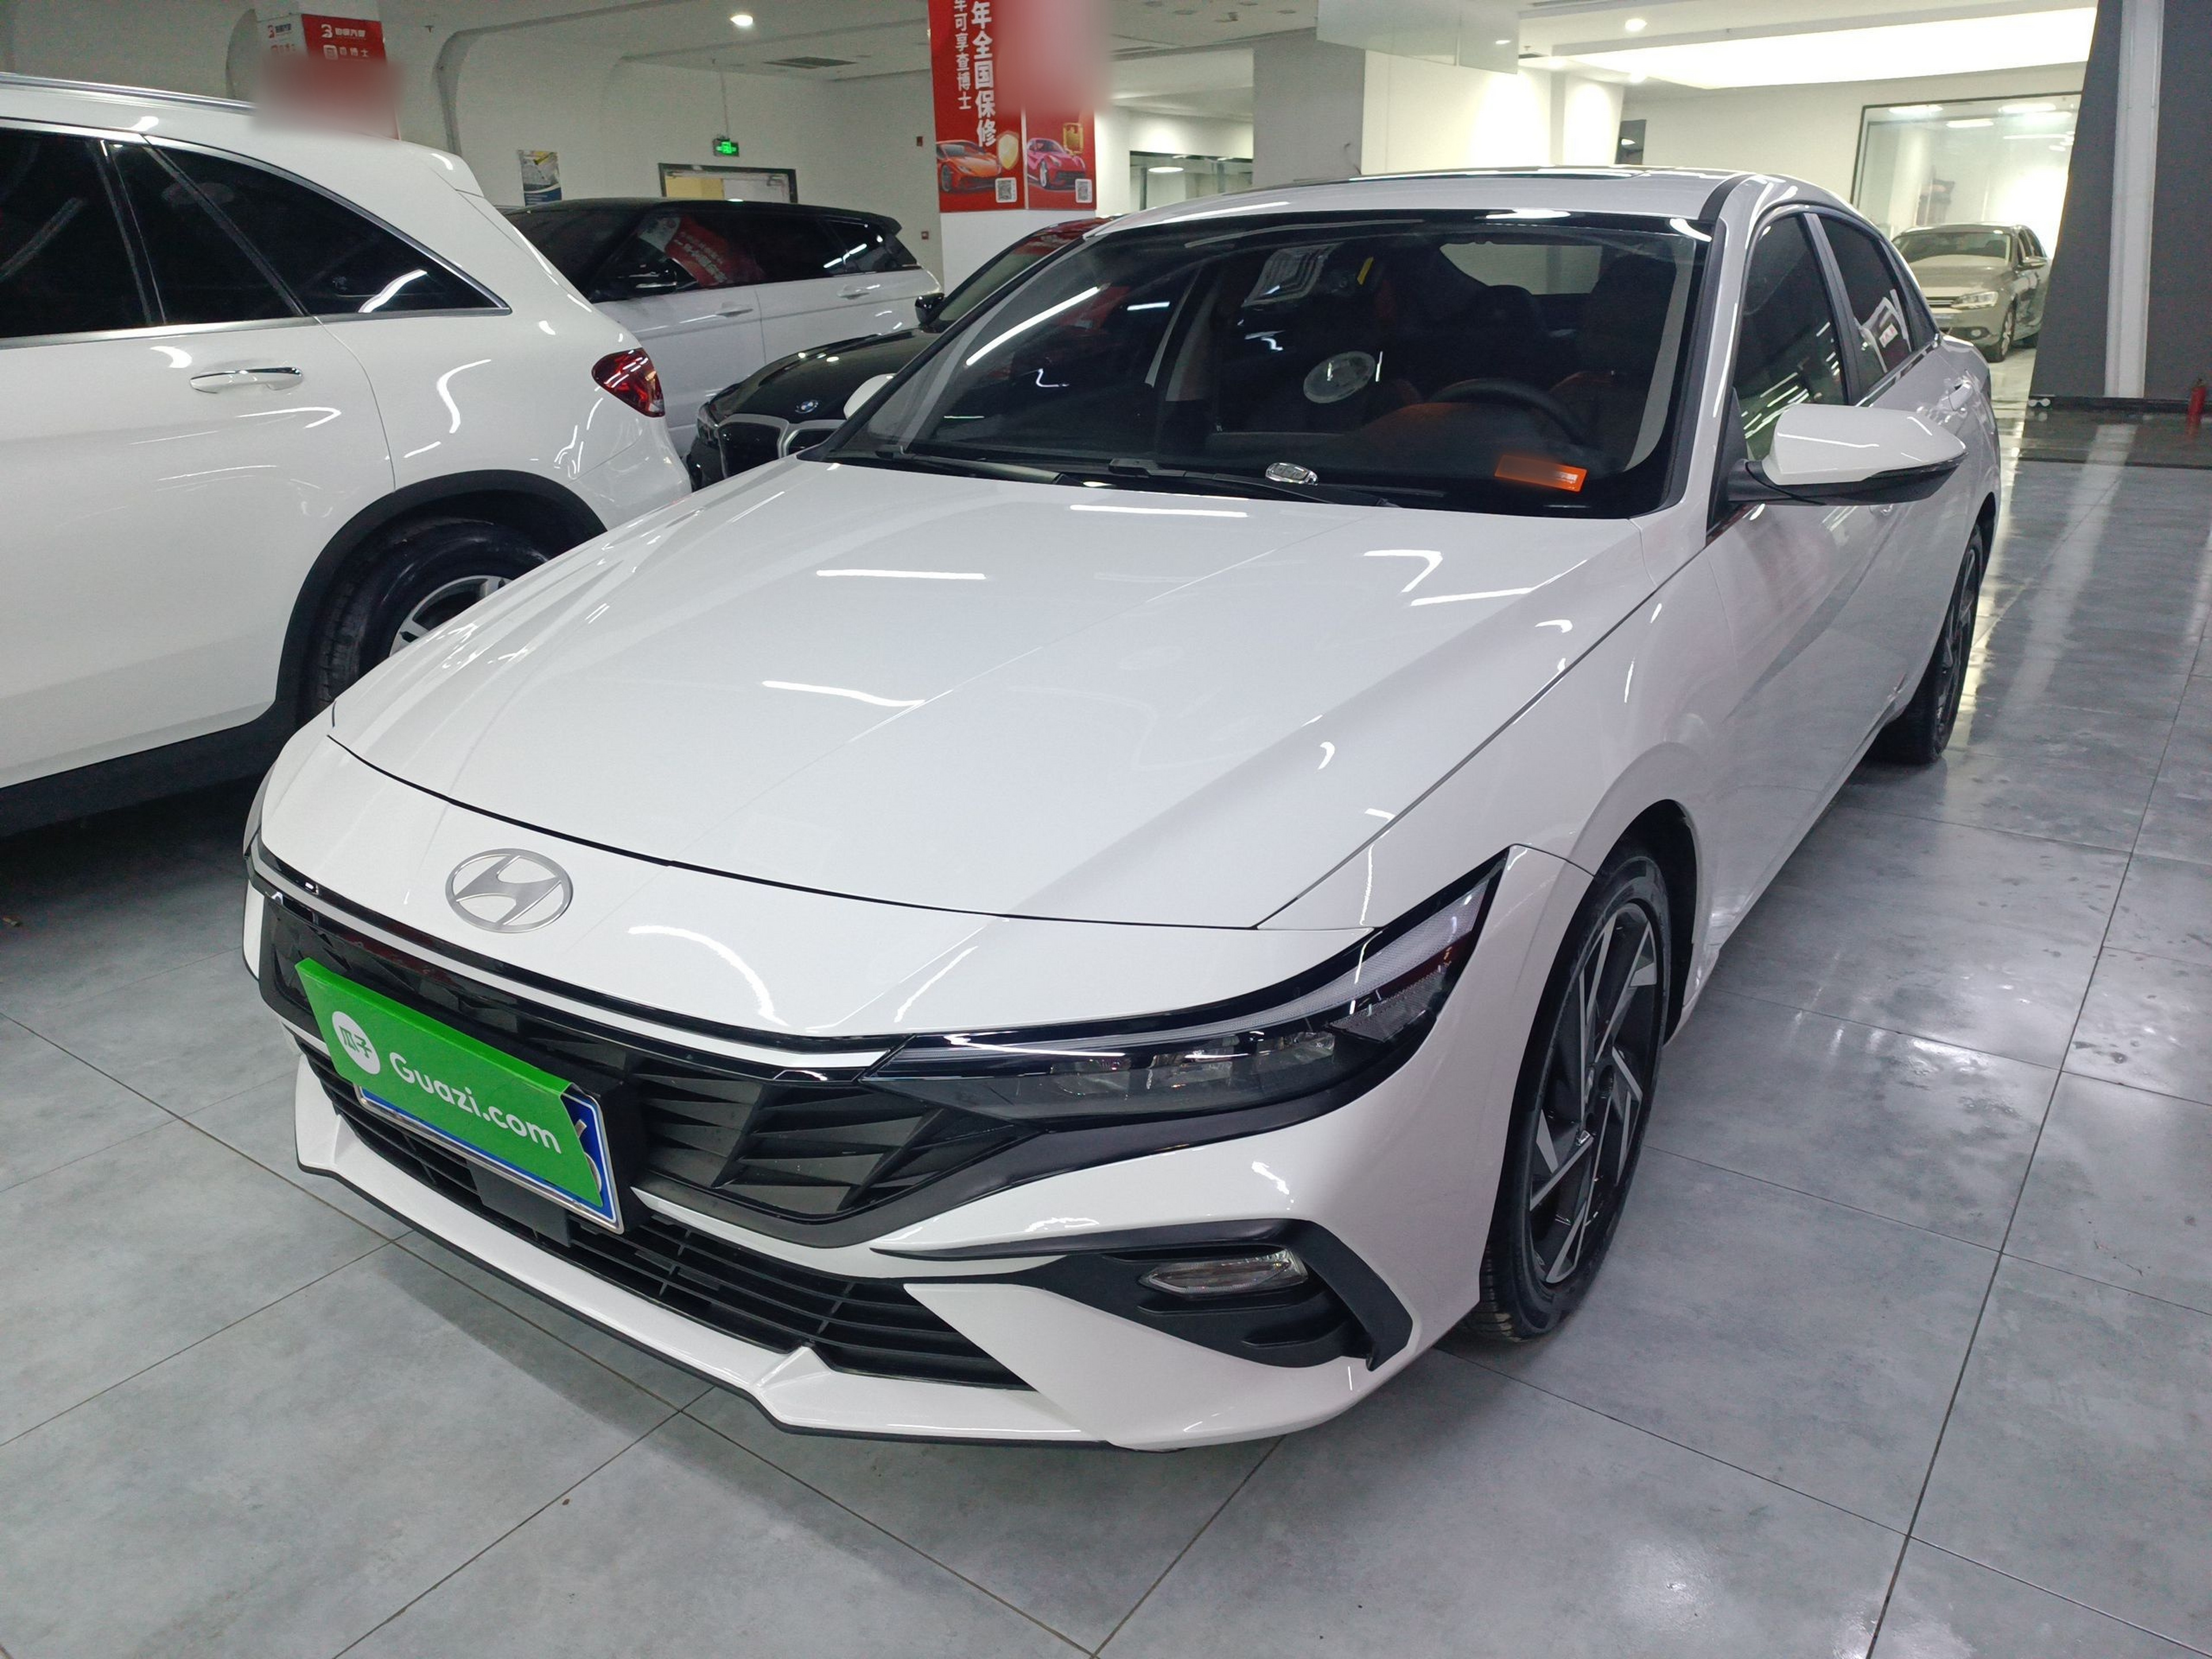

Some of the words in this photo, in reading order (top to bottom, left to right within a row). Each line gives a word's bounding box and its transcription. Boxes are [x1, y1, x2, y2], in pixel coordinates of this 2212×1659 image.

[971, 1, 997, 147] 年全国保修
[339, 1025, 373, 1059] 瓜子
[389, 1052, 562, 1154] Guazi.com
